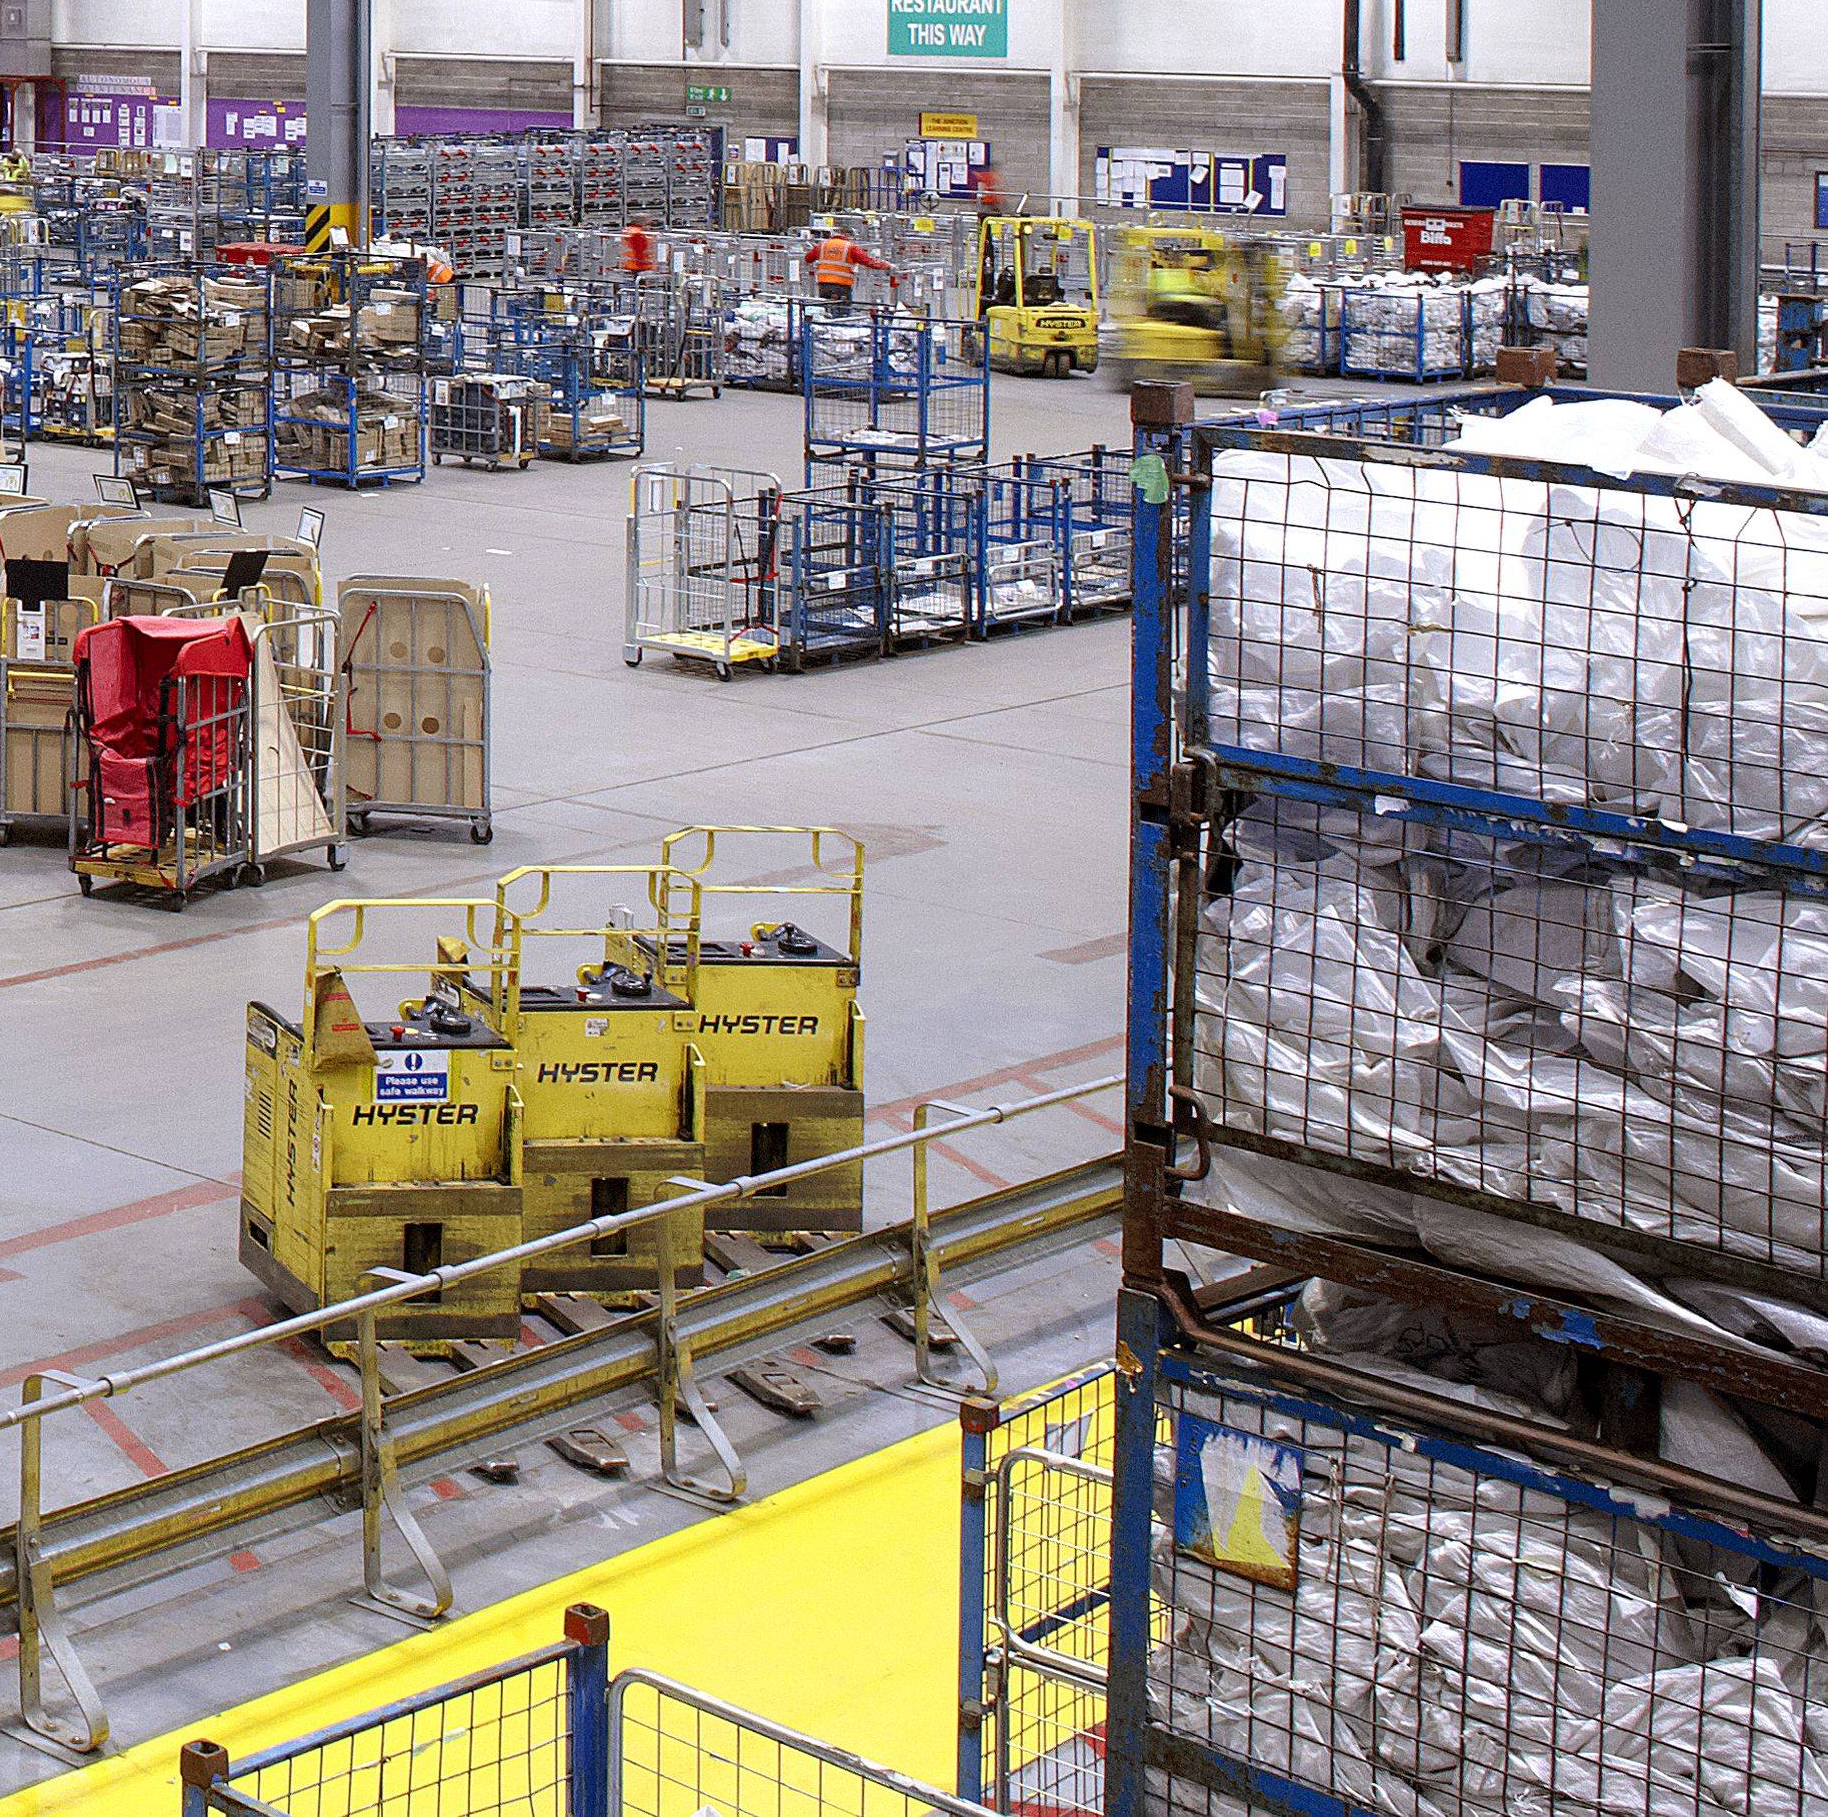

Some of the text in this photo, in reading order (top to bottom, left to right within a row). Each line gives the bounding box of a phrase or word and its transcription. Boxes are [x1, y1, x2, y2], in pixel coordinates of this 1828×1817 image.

[907, 23, 986, 46] THIS WAY
[1040, 319, 1082, 329] HYSTER
[698, 1014, 819, 1035] HYSTER
[385, 1076, 439, 1086] Please use
[537, 1061, 659, 1083] HYSTER
[380, 1087, 444, 1098] safe walkway
[352, 1104, 479, 1126] HYSTER
[286, 1079, 298, 1207] HYSTER
